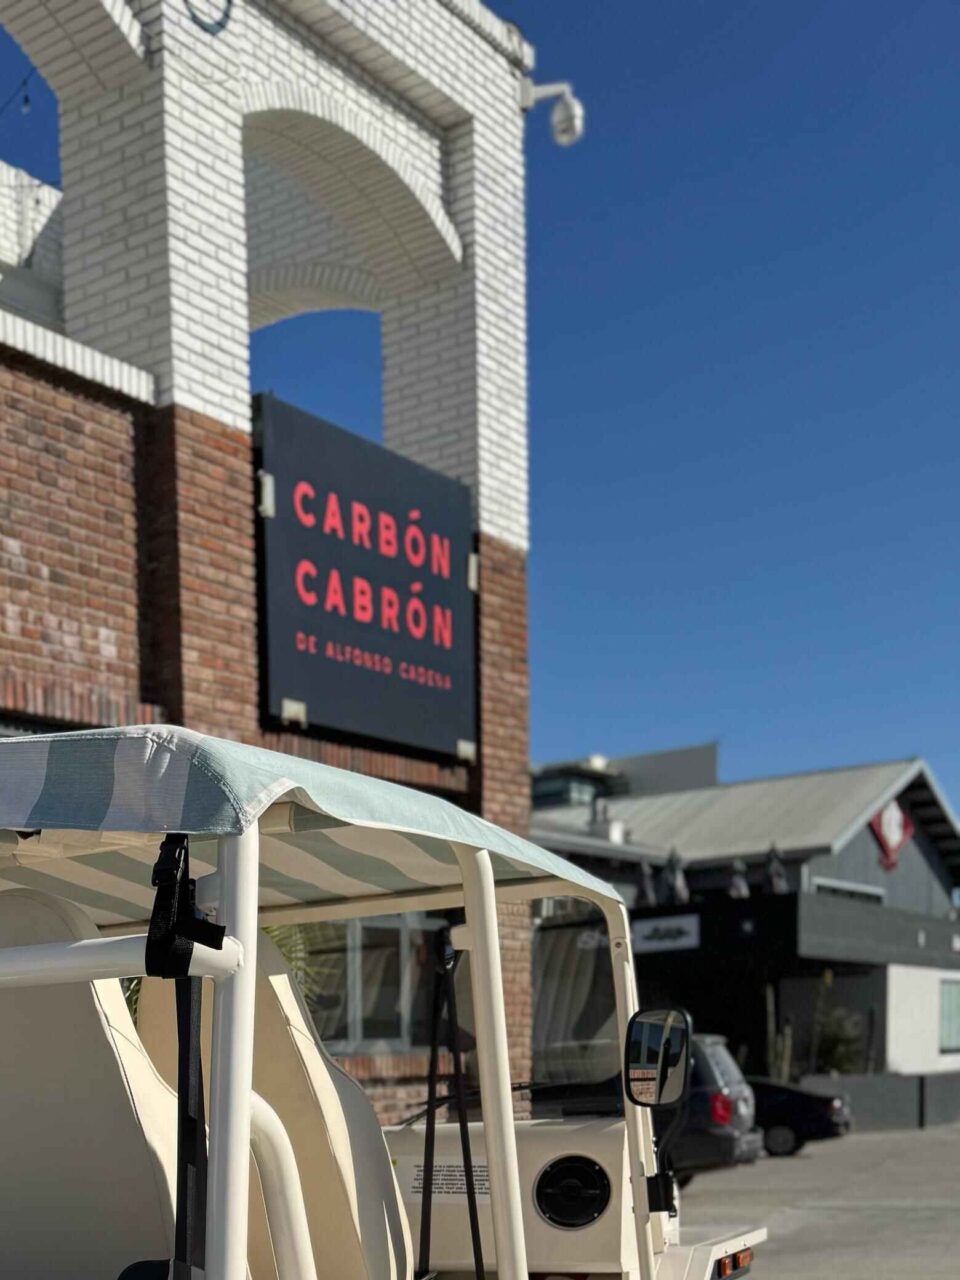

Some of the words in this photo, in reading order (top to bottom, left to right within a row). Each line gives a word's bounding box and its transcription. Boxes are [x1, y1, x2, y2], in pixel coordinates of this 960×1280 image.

[293, 481, 450, 579] CARBÓN
[294, 559, 453, 649] CABRÓN
[295, 631, 316, 654] DE
[326, 641, 392, 674] ALFONSO
